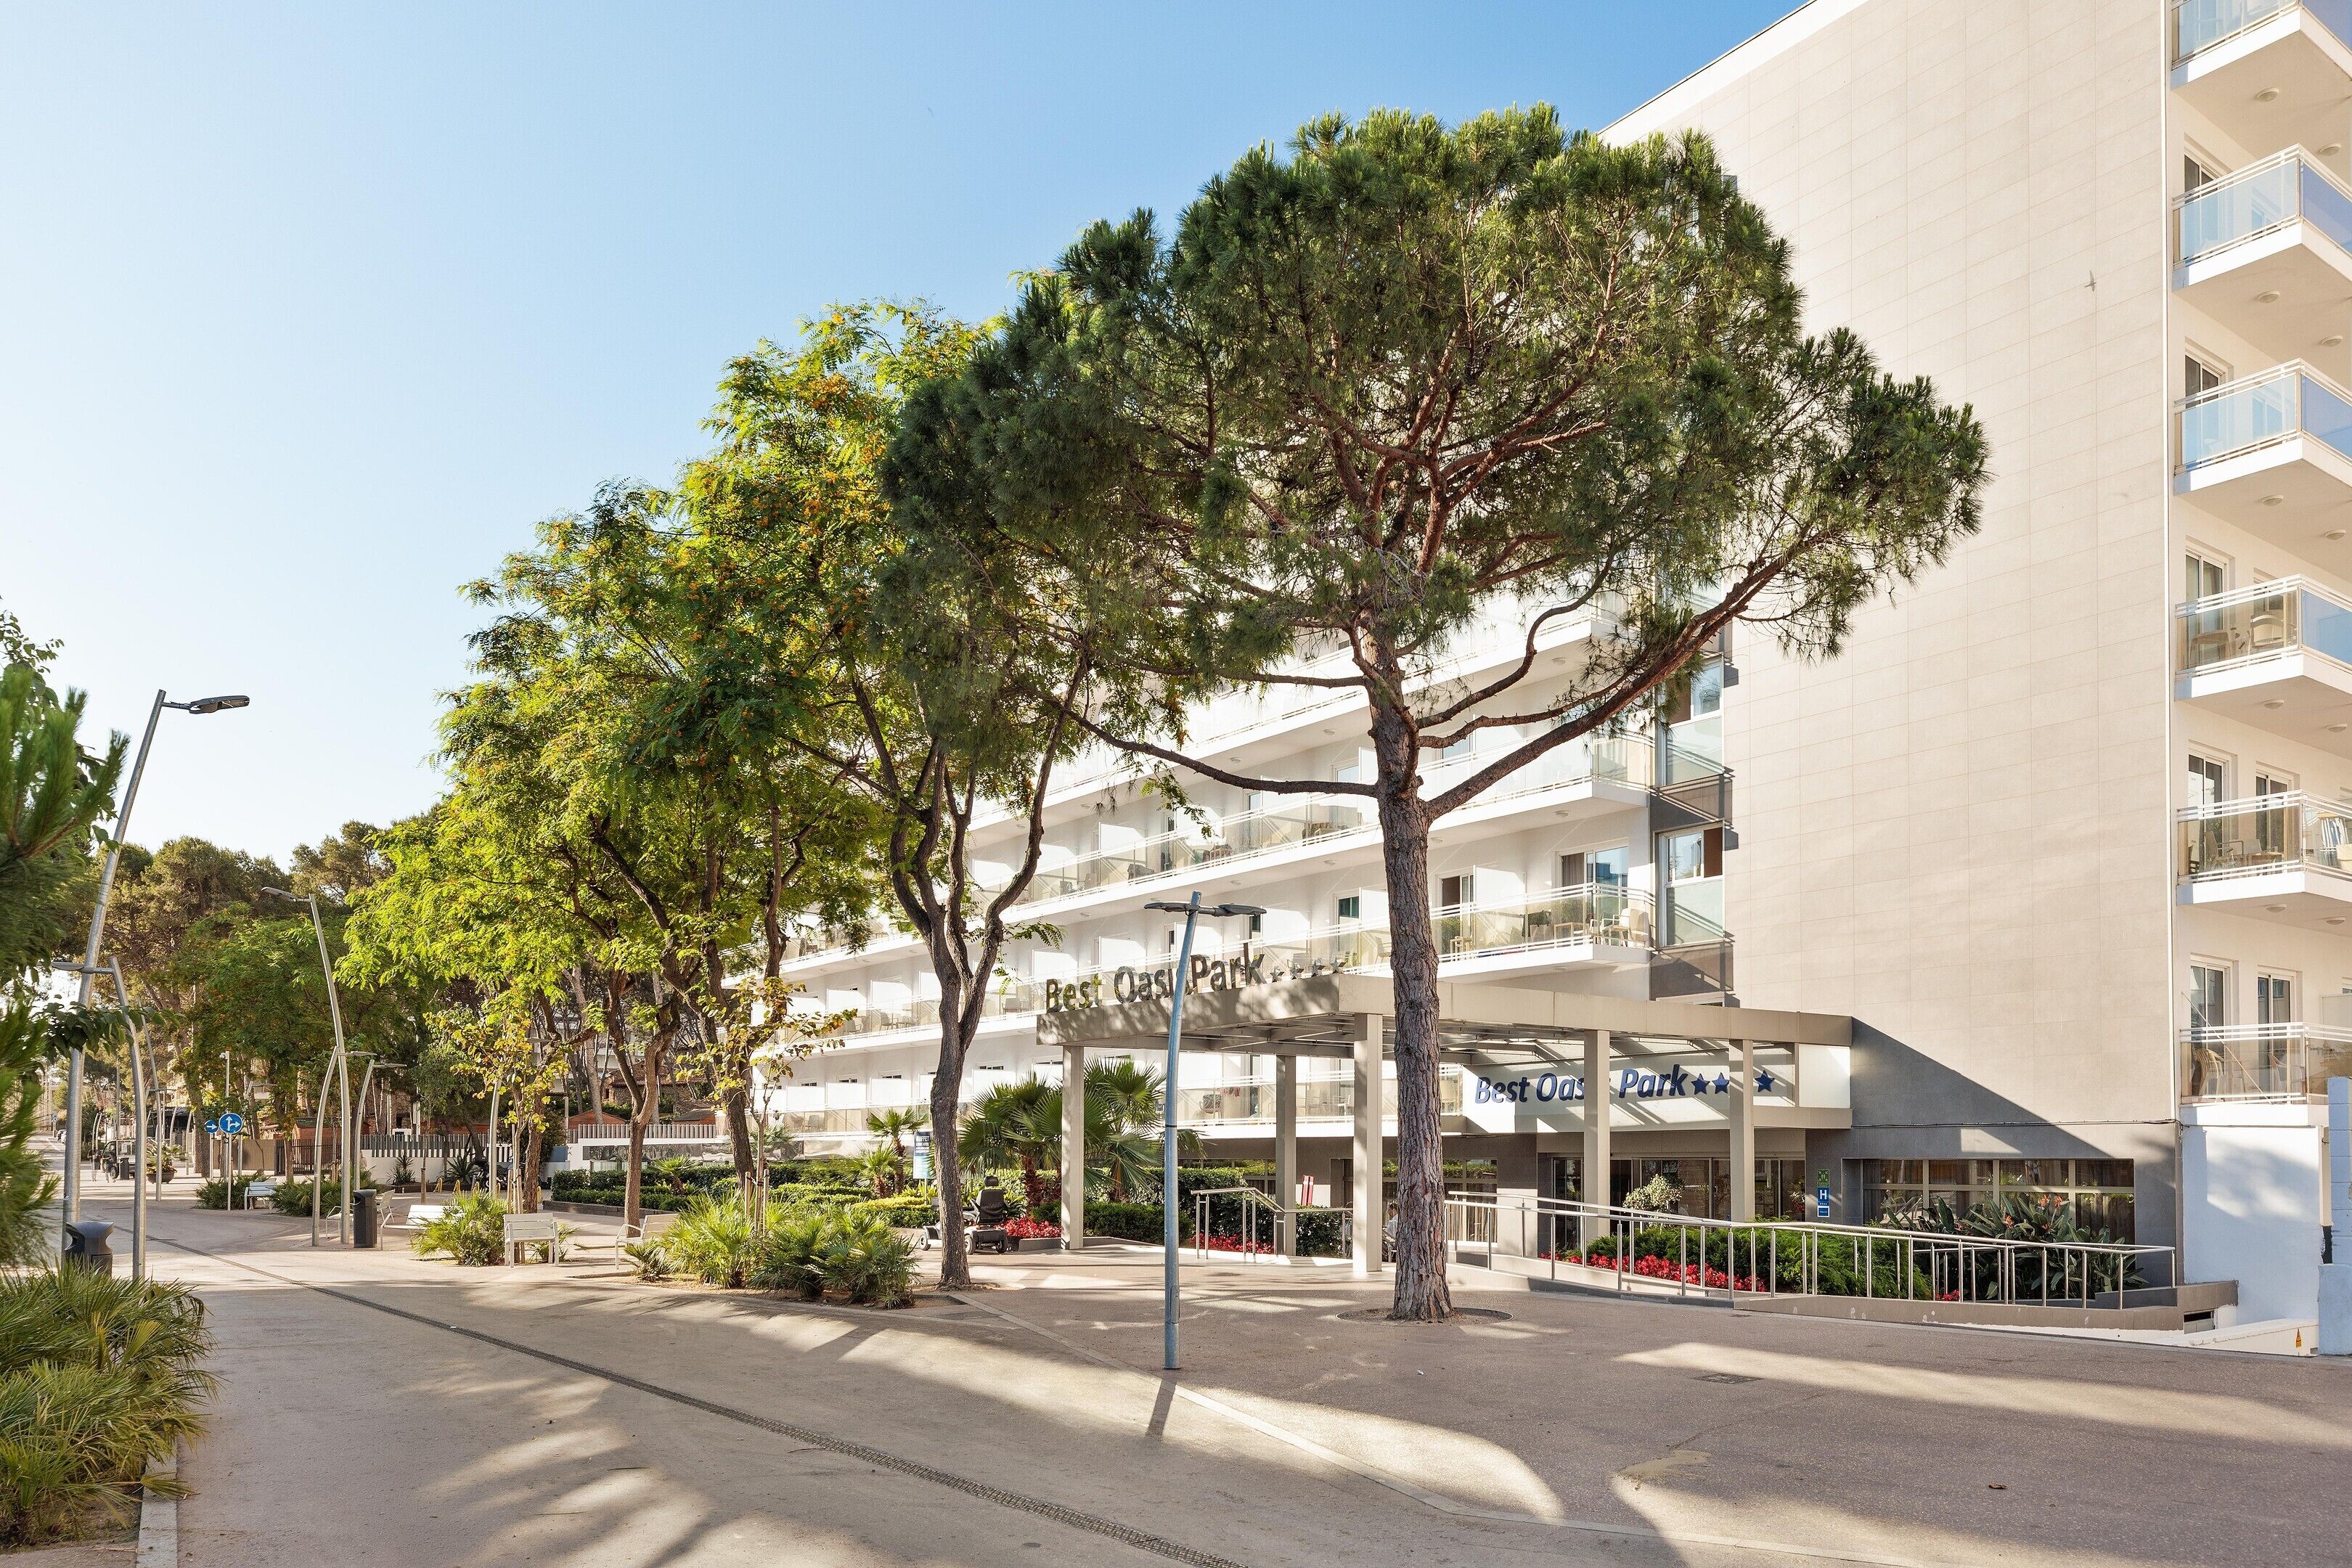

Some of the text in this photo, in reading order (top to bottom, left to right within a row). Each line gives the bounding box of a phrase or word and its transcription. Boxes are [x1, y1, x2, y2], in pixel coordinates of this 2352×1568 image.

[1046, 943, 1266, 1013] Best Oasi Park
[1474, 1063, 1688, 1103] Best Oas Park
[1819, 1189, 1827, 1200] H
